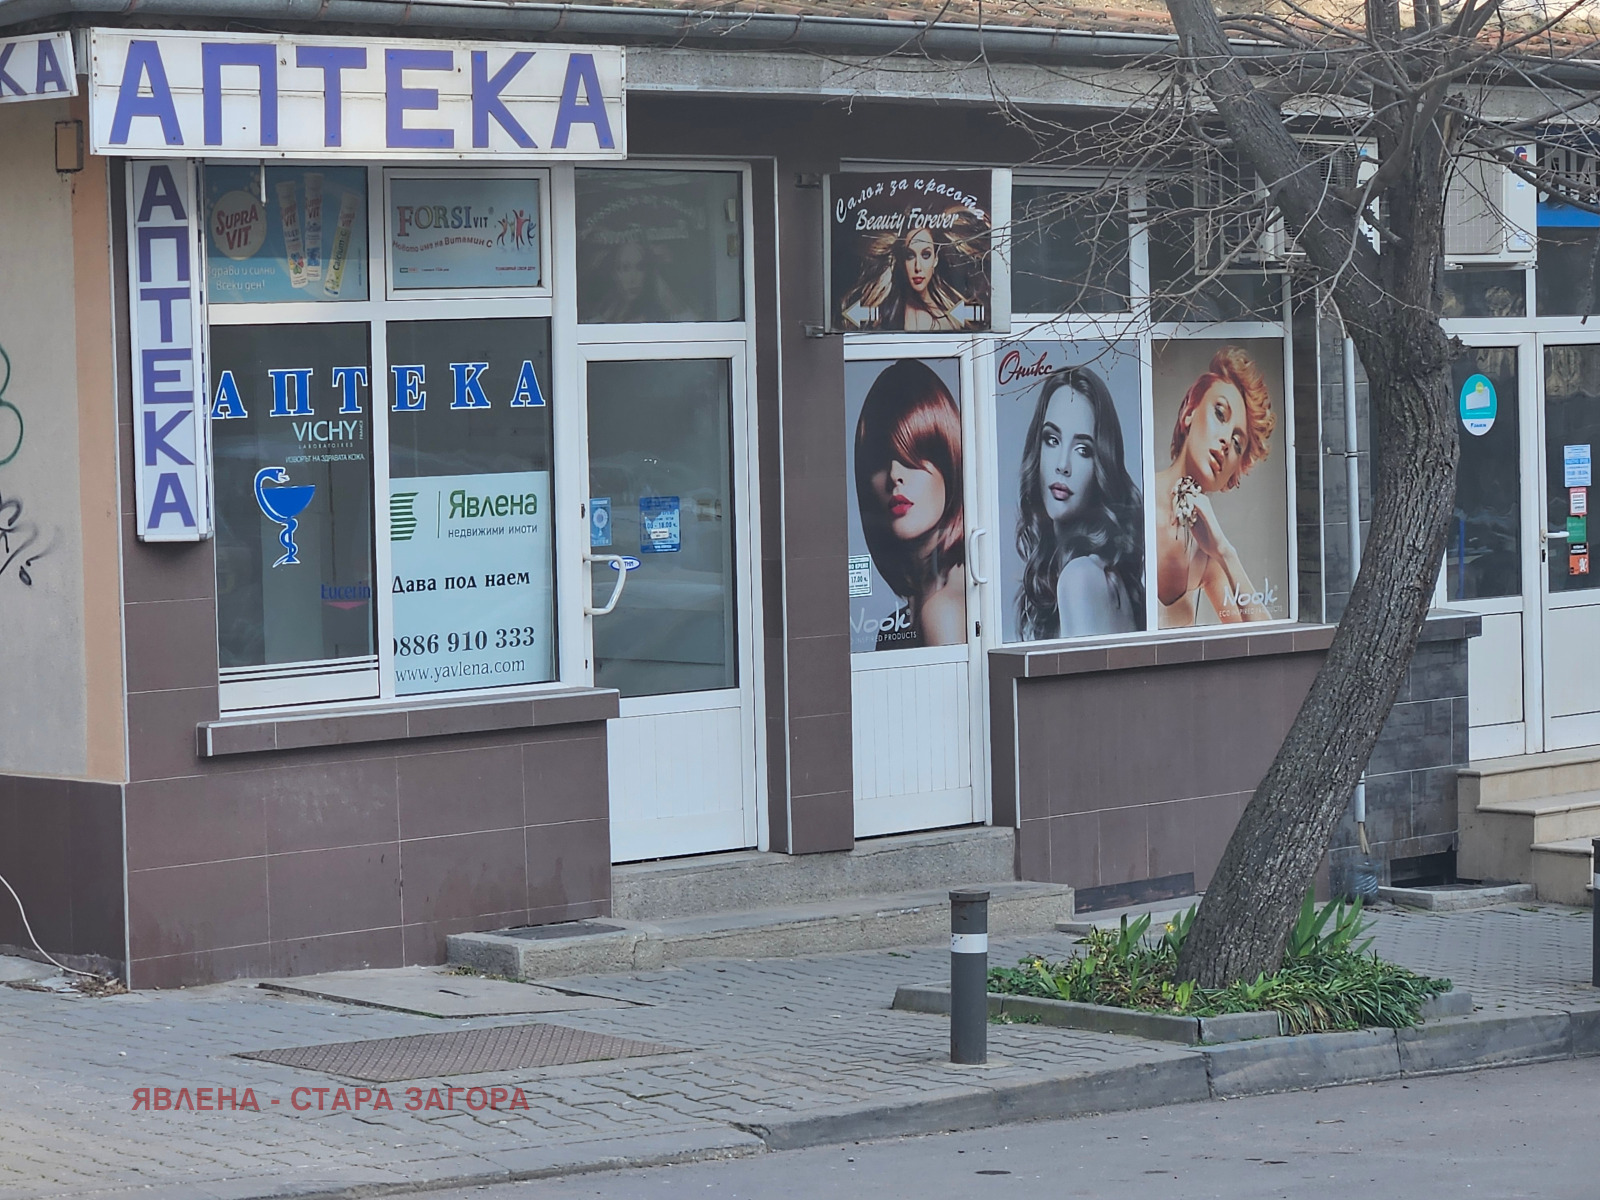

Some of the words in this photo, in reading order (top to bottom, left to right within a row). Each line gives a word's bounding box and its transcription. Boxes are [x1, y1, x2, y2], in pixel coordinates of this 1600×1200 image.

[109, 40, 614, 149] АПТЕКА
[836, 182, 884, 223] Салон
[890, 178, 908, 197] за
[914, 178, 986, 220] красота
[216, 204, 259, 236] SUPRA
[855, 208, 905, 237] Beauty
[907, 208, 959, 230] Forever
[225, 226, 252, 250] VIT
[137, 165, 196, 528] АПТЕКА
[998, 350, 1054, 385] Оникс
[211, 360, 546, 419] АПТЕКА
[292, 420, 358, 441] VICHY
[448, 489, 538, 519] Явлена
[448, 527, 505, 539] недвижими
[508, 523, 538, 534] имоти
[392, 574, 437, 594] Дава
[444, 576, 477, 590] под
[485, 571, 530, 587] наем
[1223, 577, 1278, 606] Nook
[447, 630, 488, 653] 910
[495, 626, 535, 650] 333
[884, 631, 917, 641] PRODUCTS
[395, 659, 526, 683] www.yavlena.com
